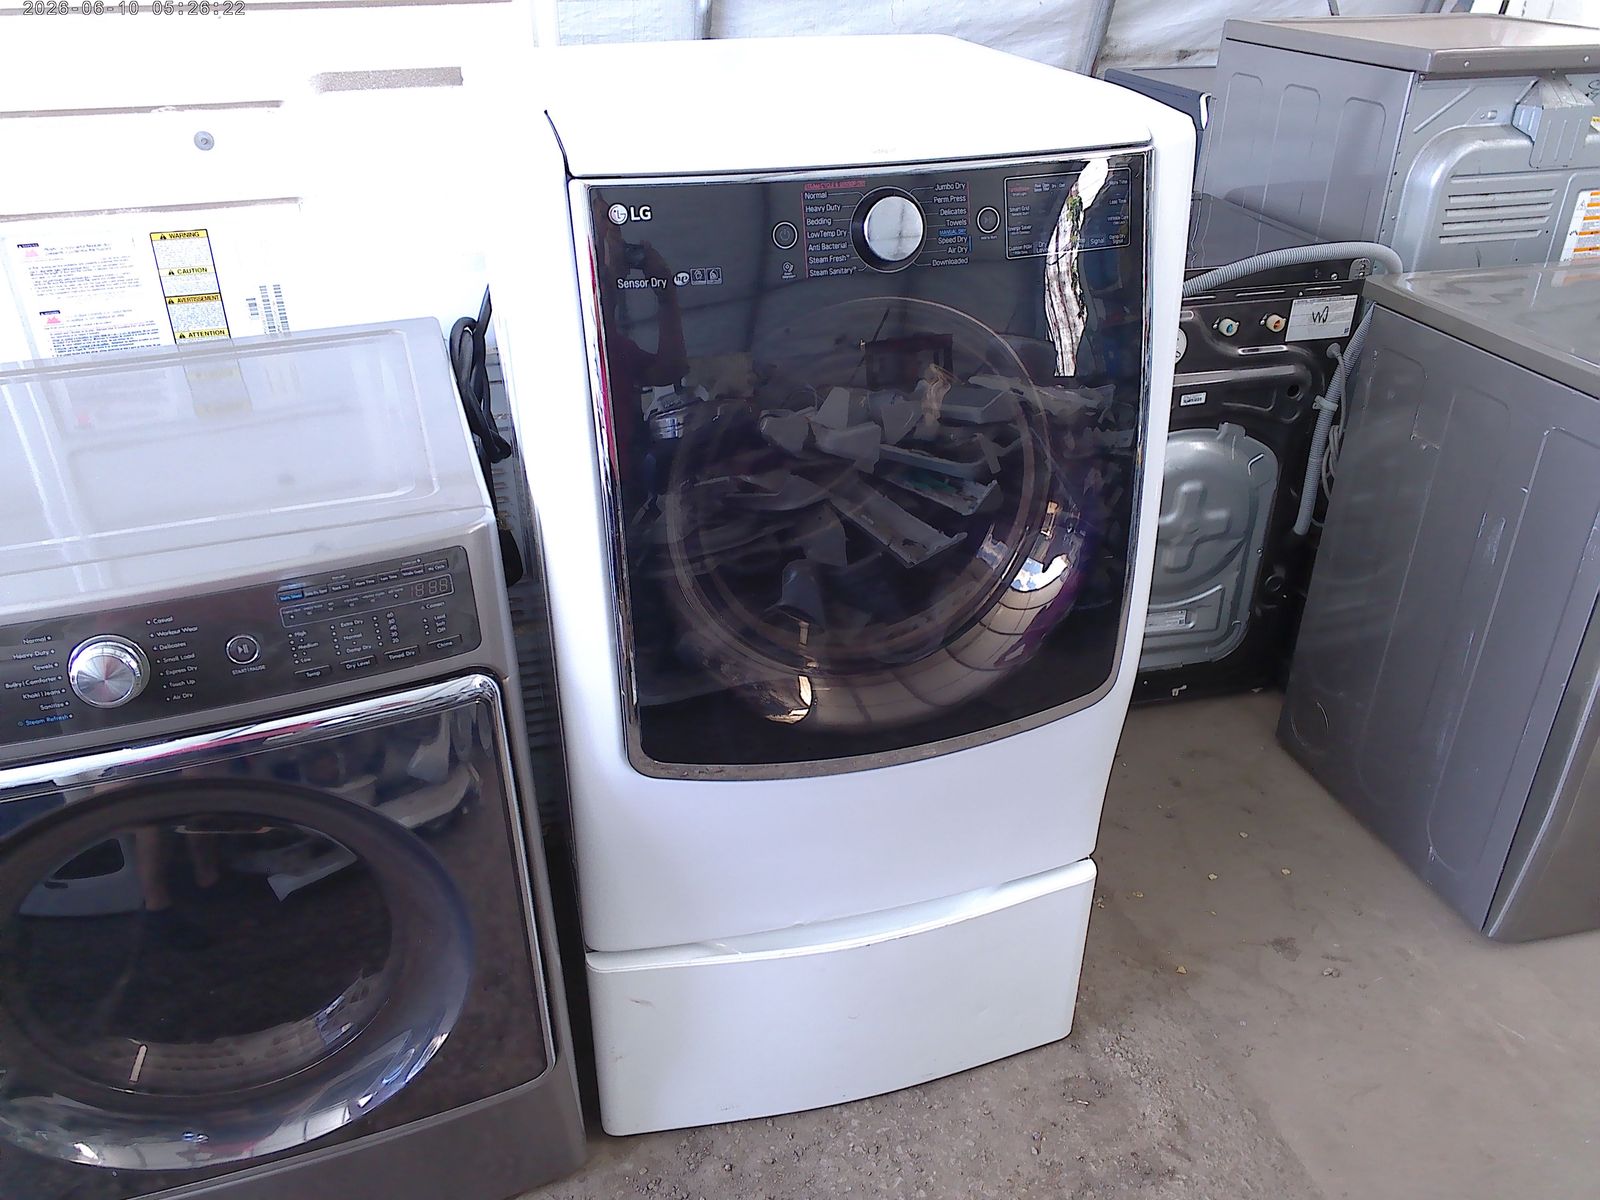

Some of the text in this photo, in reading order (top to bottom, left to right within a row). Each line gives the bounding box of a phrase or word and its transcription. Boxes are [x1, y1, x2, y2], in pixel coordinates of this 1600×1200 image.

[630, 206, 651, 220] LG
[822, 242, 847, 250] Bacterial
[933, 257, 968, 266] Downloaded
[810, 269, 828, 277] Steam
[617, 277, 666, 288] Sensor Dry
[153, 616, 173, 624] Casual
[23, 636, 46, 645] Normal
[159, 642, 186, 650] Delicates
[26, 676, 56, 686] Comforter
